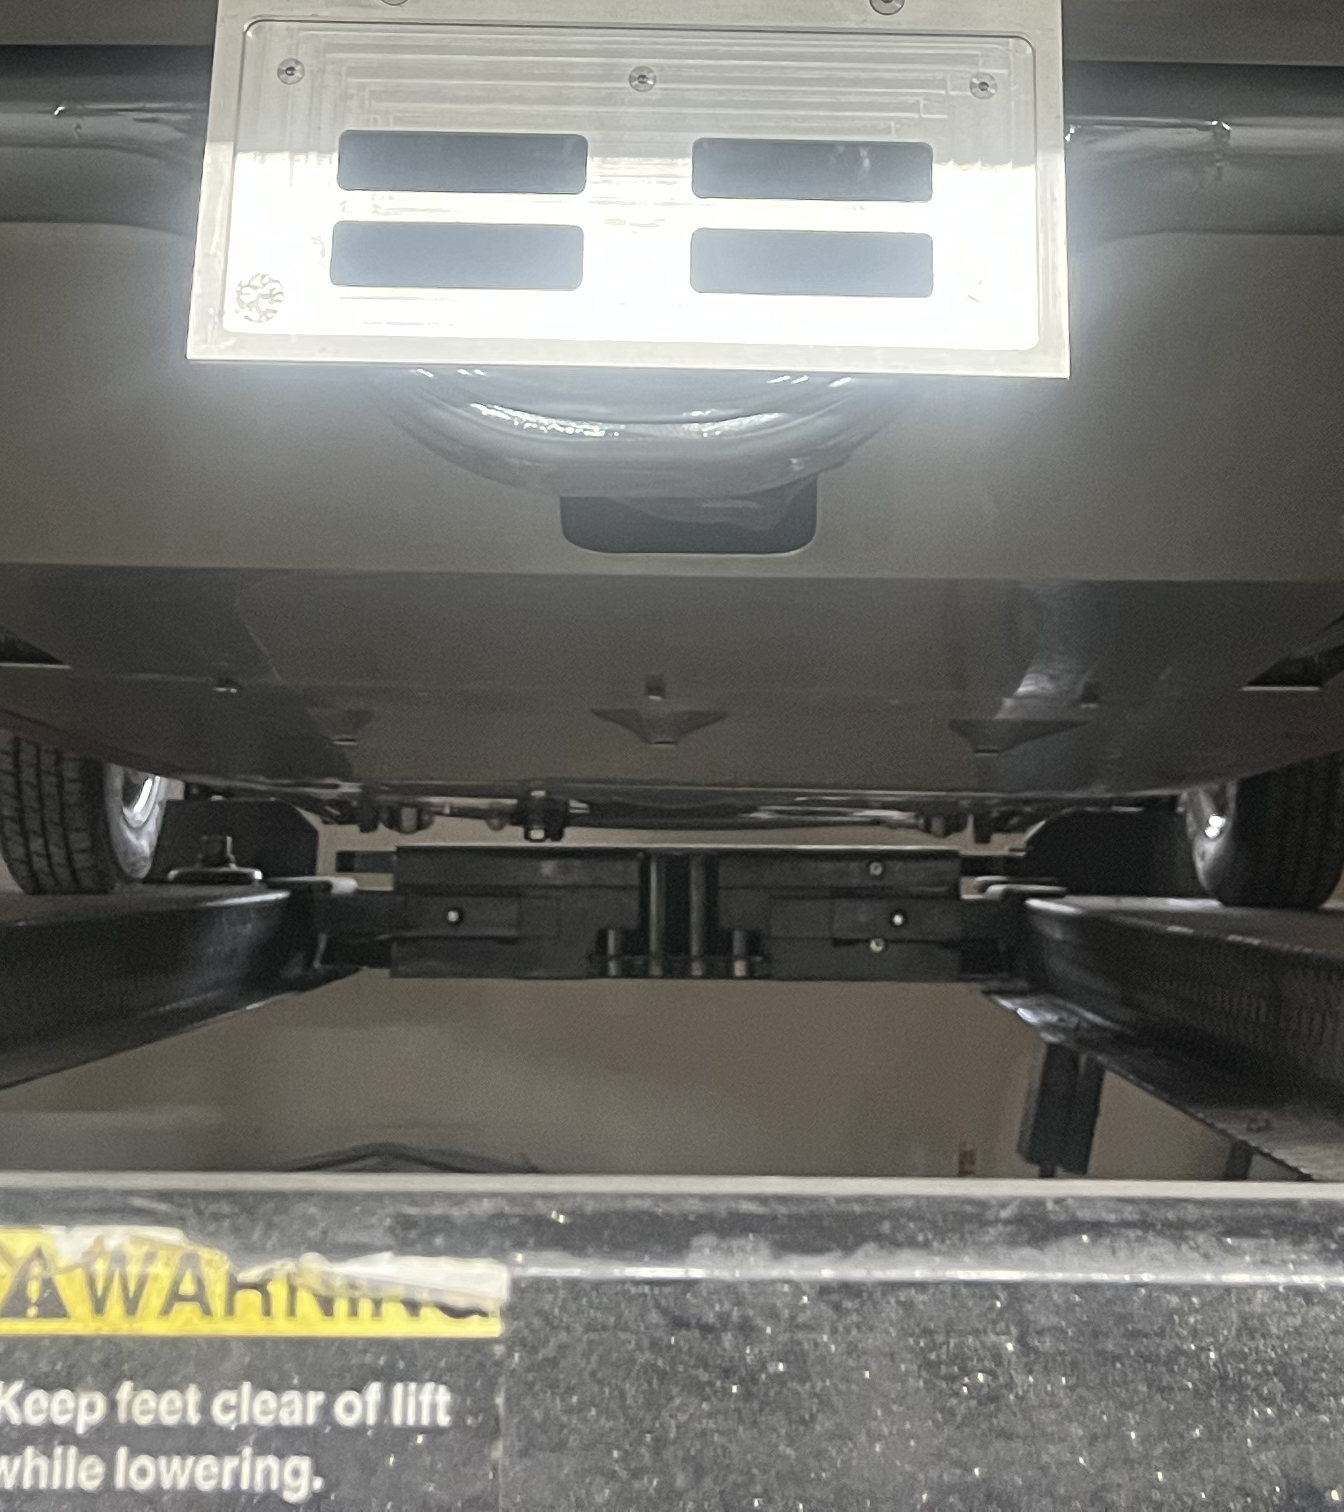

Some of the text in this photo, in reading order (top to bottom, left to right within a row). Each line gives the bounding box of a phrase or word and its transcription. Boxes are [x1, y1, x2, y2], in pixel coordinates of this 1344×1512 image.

[115, 1380, 202, 1426] feet
[210, 1380, 326, 1427] clear
[333, 1381, 382, 1427] of
[391, 1381, 452, 1427] lift
[114, 1445, 323, 1504] lowering.
